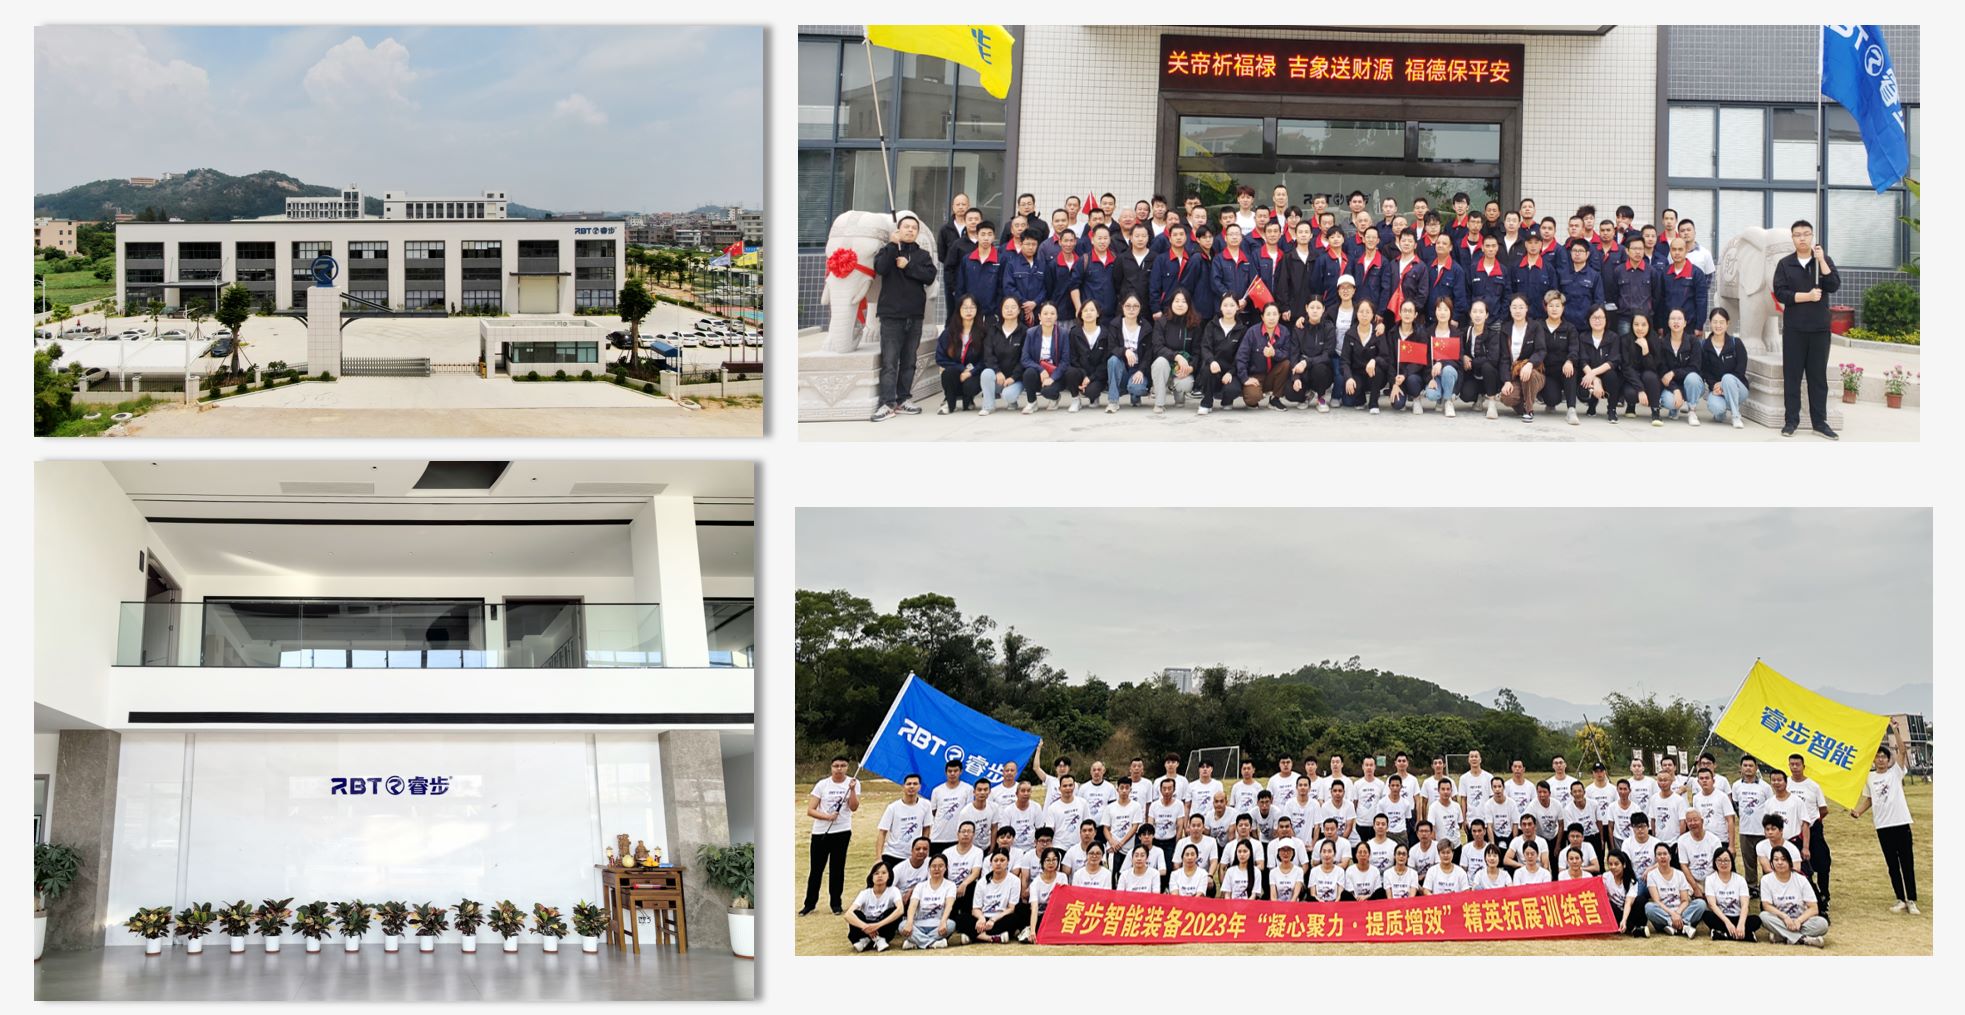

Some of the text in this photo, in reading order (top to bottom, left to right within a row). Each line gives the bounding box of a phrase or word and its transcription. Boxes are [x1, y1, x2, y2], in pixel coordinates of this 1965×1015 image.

[1168, 51, 1511, 83] 关帝祈福禄 吉象送财源 福德保平安
[1303, 193, 1333, 205] RT
[897, 718, 1004, 783] RBT 睿步
[1760, 706, 1858, 771] 睿步智能
[331, 776, 450, 796] RBT 睿步
[1060, 900, 1247, 939] 睿步智能装备2023年
[1462, 891, 1602, 933] 精英拓展训练营
